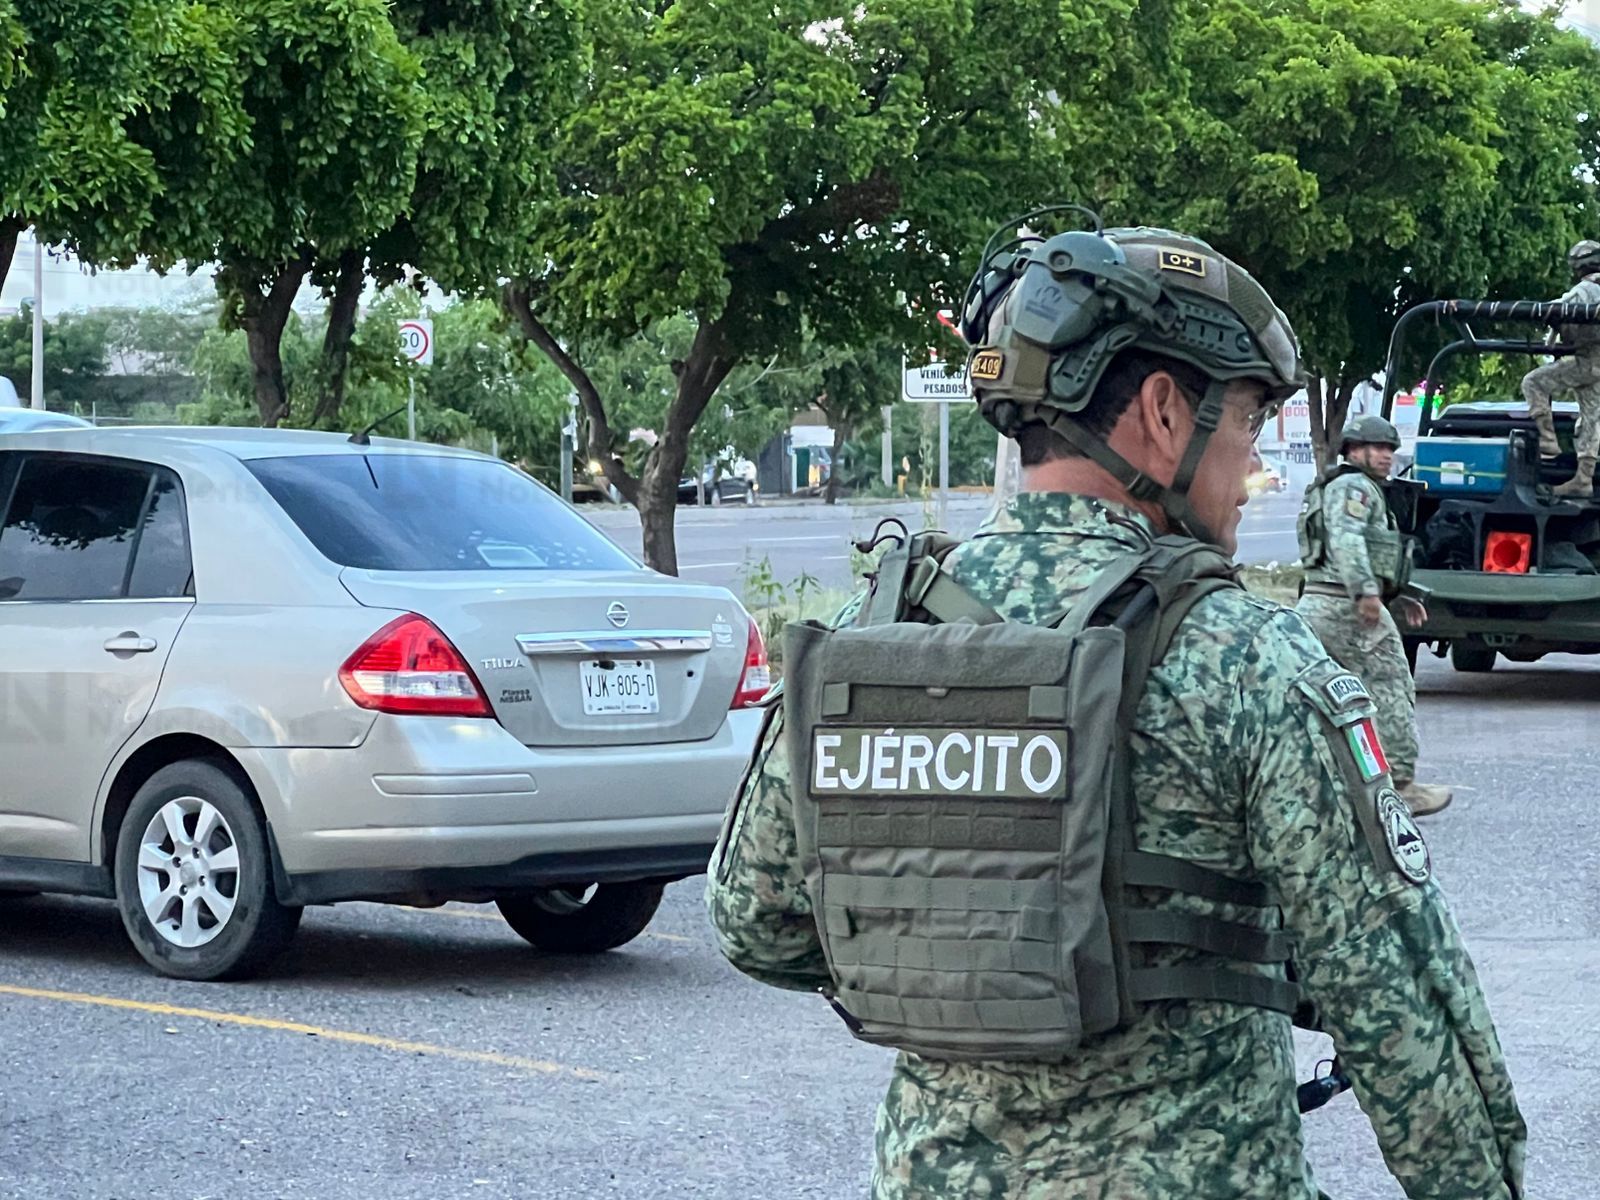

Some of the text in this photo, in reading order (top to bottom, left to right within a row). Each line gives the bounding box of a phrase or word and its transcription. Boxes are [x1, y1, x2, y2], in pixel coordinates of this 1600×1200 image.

[399, 332, 420, 348] 50
[923, 383, 966, 394] PESADOS
[480, 657, 526, 669] TIIDA
[584, 674, 656, 698] VJK-805-D
[814, 728, 1062, 793] EJÉRCITO
